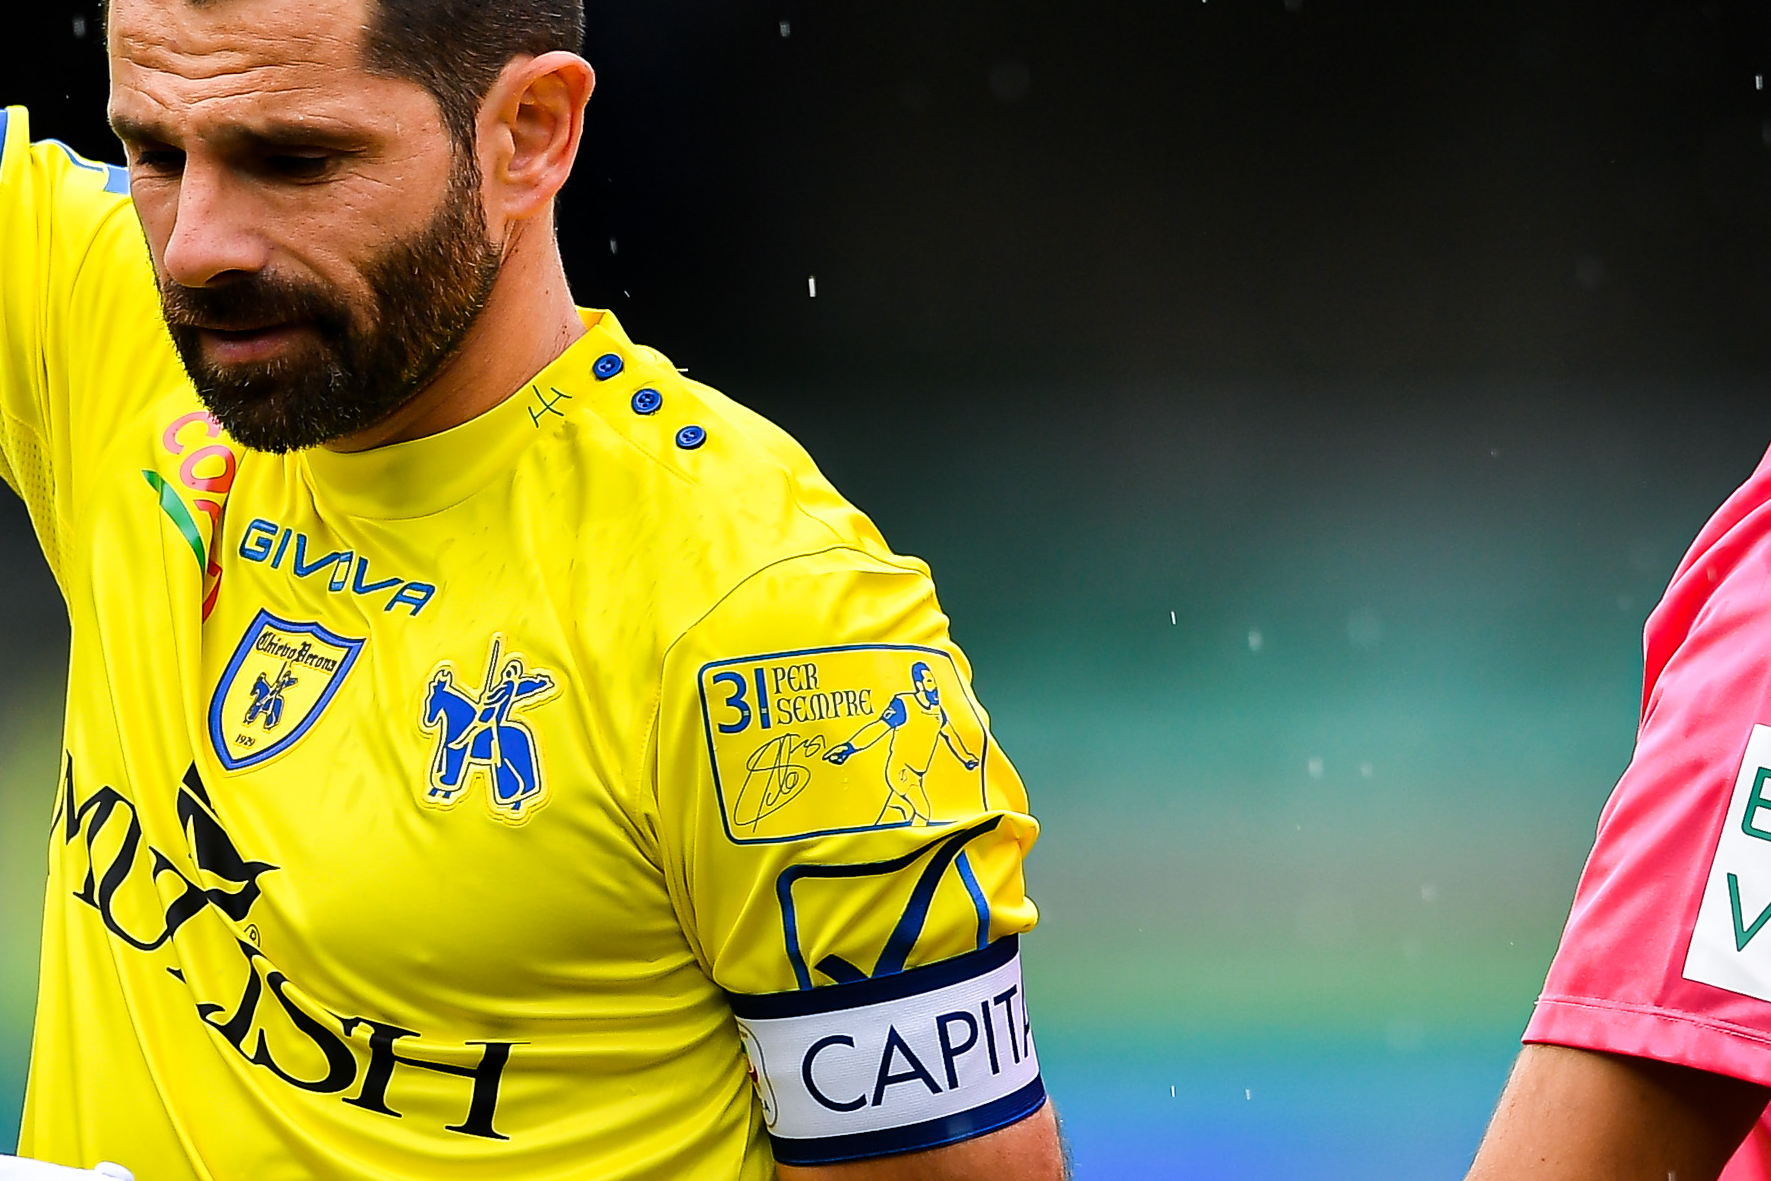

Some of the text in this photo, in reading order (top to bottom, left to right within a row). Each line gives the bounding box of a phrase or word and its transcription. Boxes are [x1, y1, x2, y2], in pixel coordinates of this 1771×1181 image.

[239, 518, 436, 617] GIVOVA
[771, 663, 821, 695] PER
[712, 667, 772, 734] 31
[777, 689, 875, 725] SEMPRE
[235, 734, 256, 747] 1929
